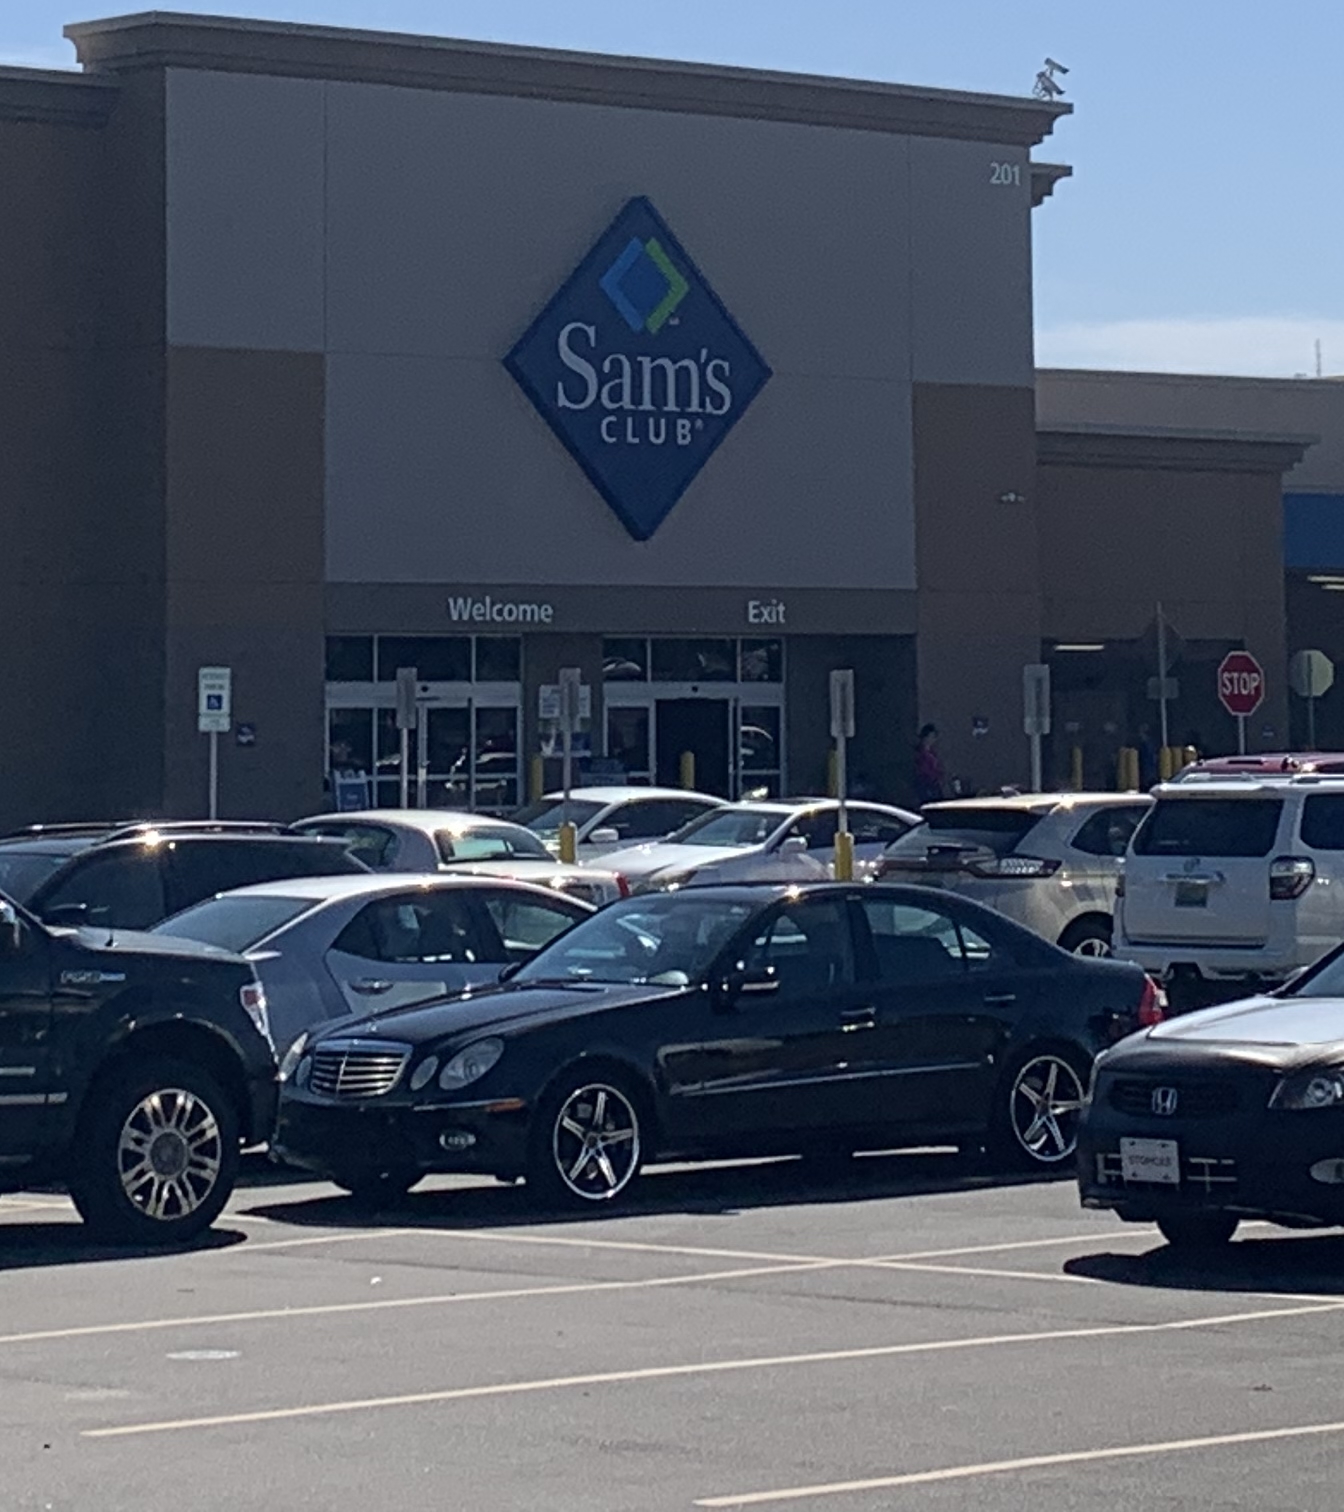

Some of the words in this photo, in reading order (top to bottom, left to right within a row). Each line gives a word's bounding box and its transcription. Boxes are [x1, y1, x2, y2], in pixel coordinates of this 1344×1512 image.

[989, 161, 1021, 186] 201
[557, 322, 733, 415] Sam's
[447, 595, 554, 623] Welcome
[748, 598, 786, 624] Exit
[1222, 671, 1261, 695] STOP
